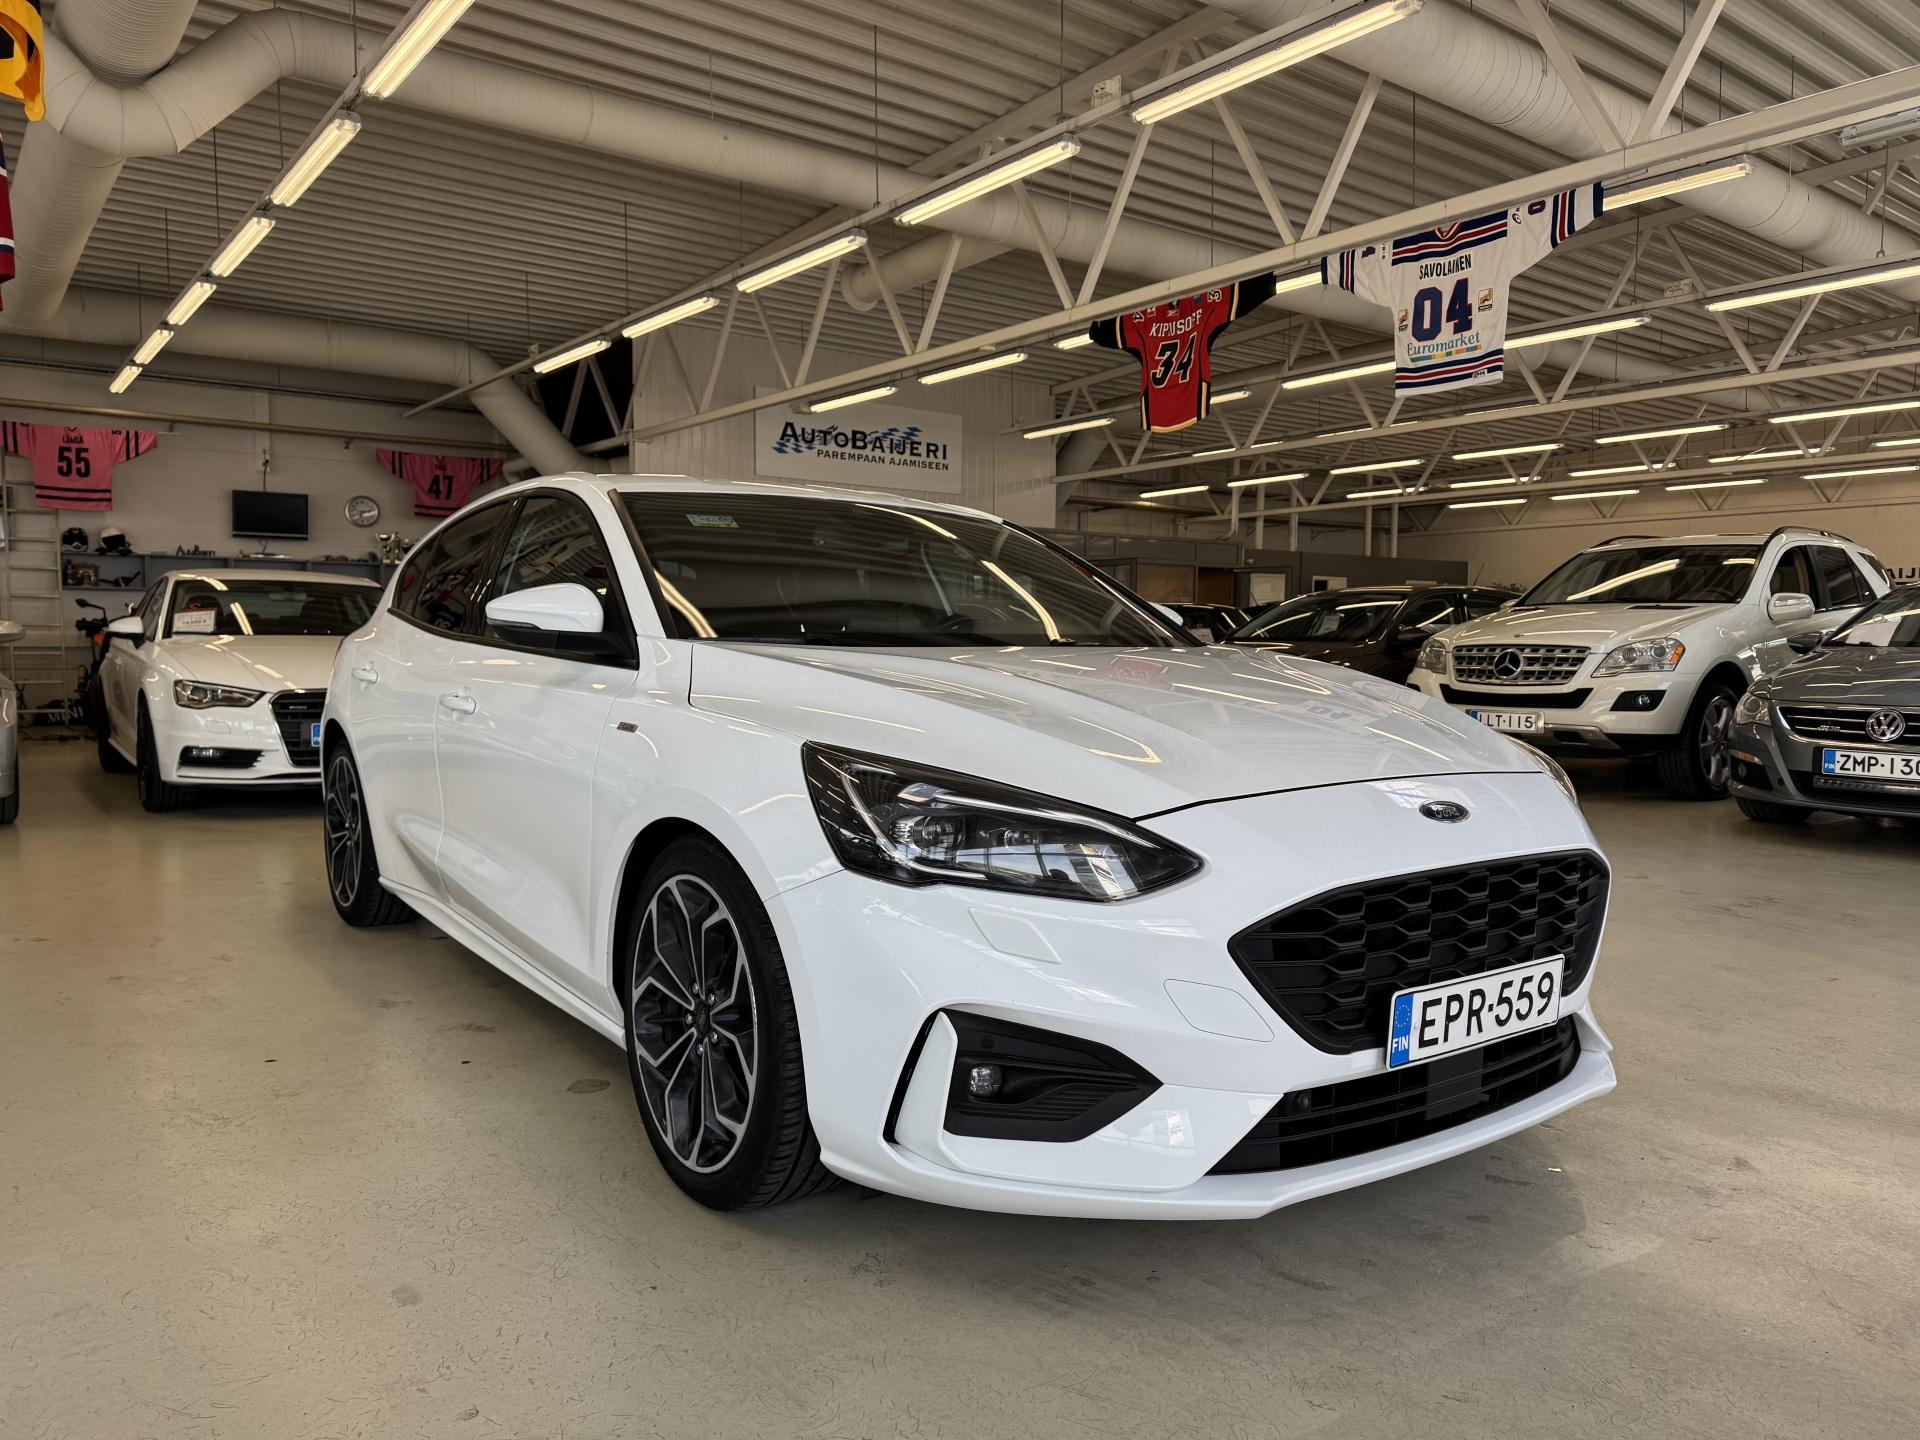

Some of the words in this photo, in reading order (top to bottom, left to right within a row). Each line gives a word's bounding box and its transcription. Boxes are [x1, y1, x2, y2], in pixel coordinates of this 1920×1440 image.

[1411, 277, 1473, 343] 04
[1407, 331, 1481, 357] Euromarket
[1150, 331, 1198, 389] 34
[57, 445, 91, 478] 55
[817, 449, 886, 465] PAREMPAAN
[889, 456, 949, 471] AJAMISEEN
[427, 474, 454, 500] 47
[1418, 971, 1555, 1049] EPR-559
[1391, 1034, 1411, 1054] FIN
